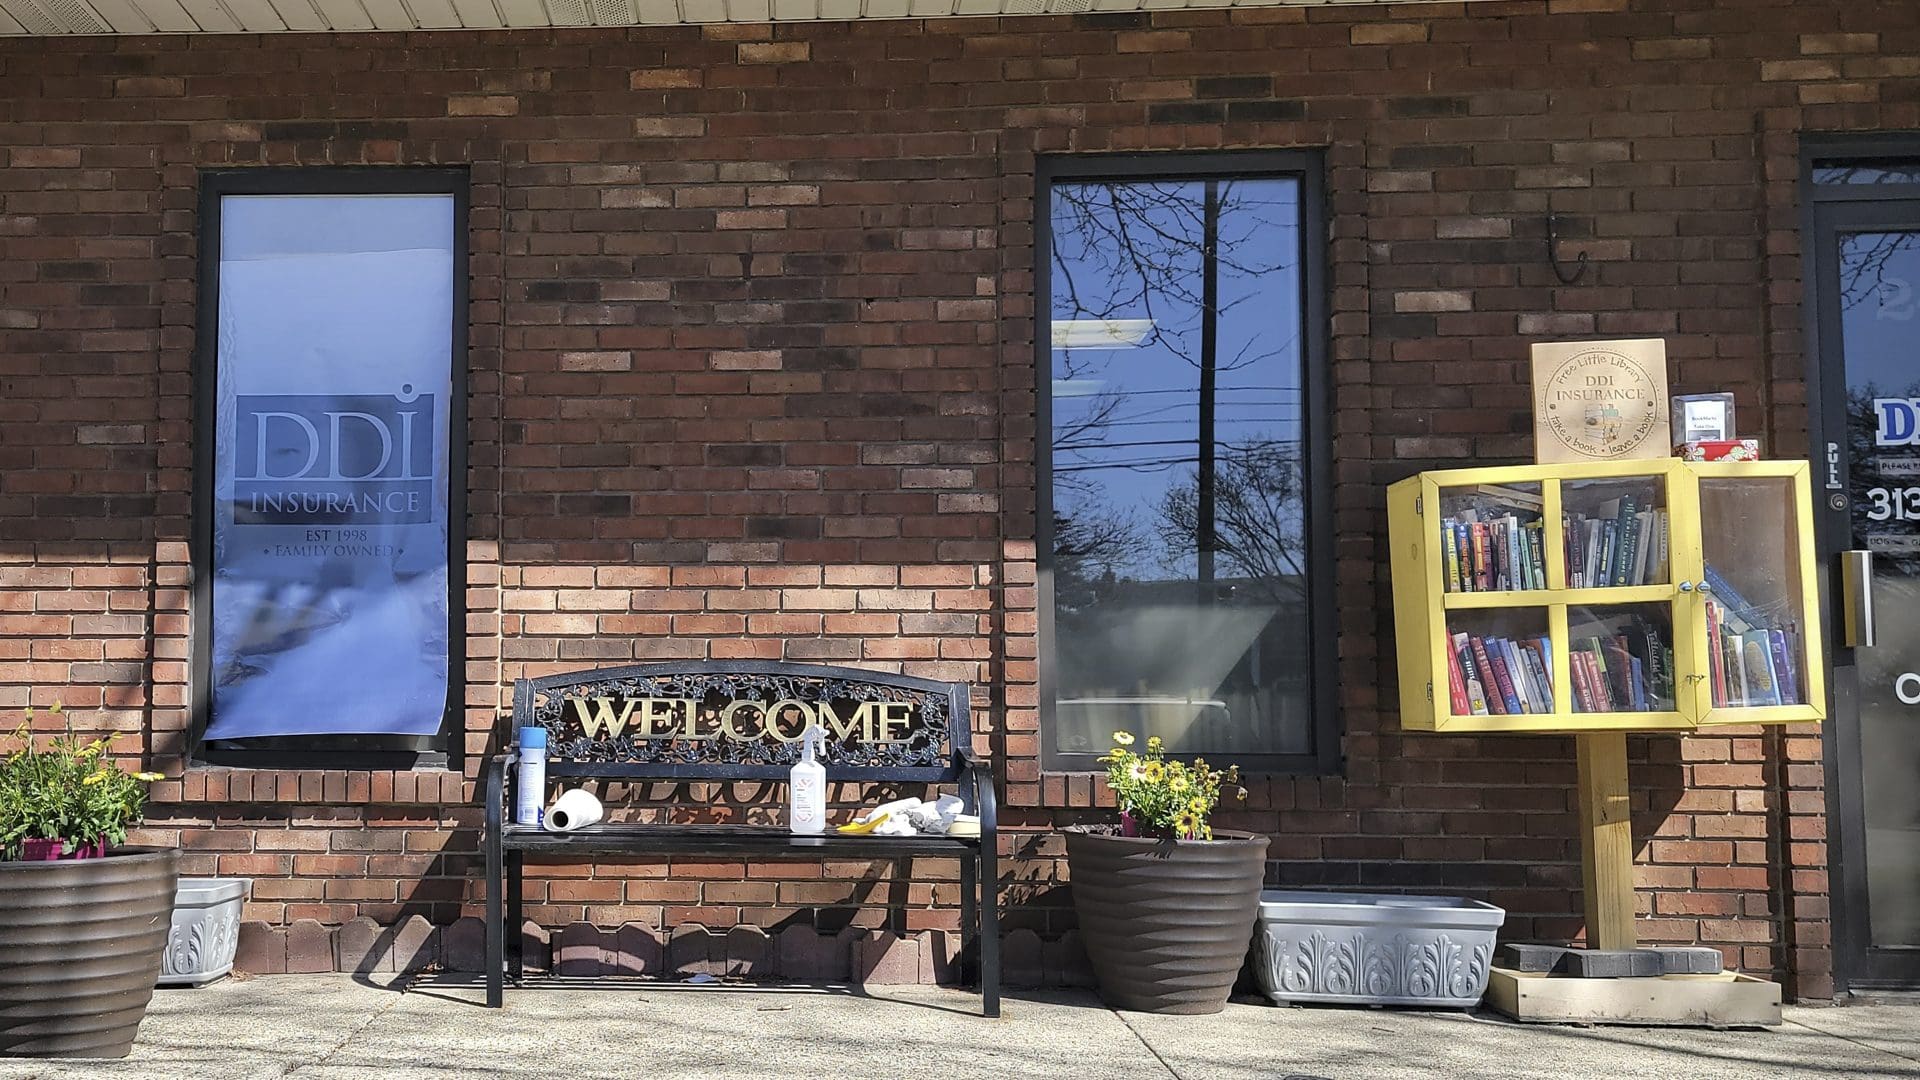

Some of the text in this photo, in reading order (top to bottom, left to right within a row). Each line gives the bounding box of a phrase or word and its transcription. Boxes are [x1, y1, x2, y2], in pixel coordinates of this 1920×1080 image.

[1556, 354, 1644, 384] Free Little Library
[1585, 375, 1614, 386] DDI
[1556, 388, 1645, 401] INSURANCE
[1573, 438, 1597, 454] book
[1608, 440, 1634, 454] leave
[1636, 411, 1654, 434] book
[1874, 398, 1920, 446] D
[1828, 442, 1838, 484] PULL
[1881, 462, 1911, 471] PLEASE
[250, 491, 419, 513] INSURANCE
[1867, 487, 1920, 520] 313
[305, 530, 367, 541] EST 1998
[275, 545, 393, 556] FAMILY OWNED
[573, 697, 919, 744] WELCOME
